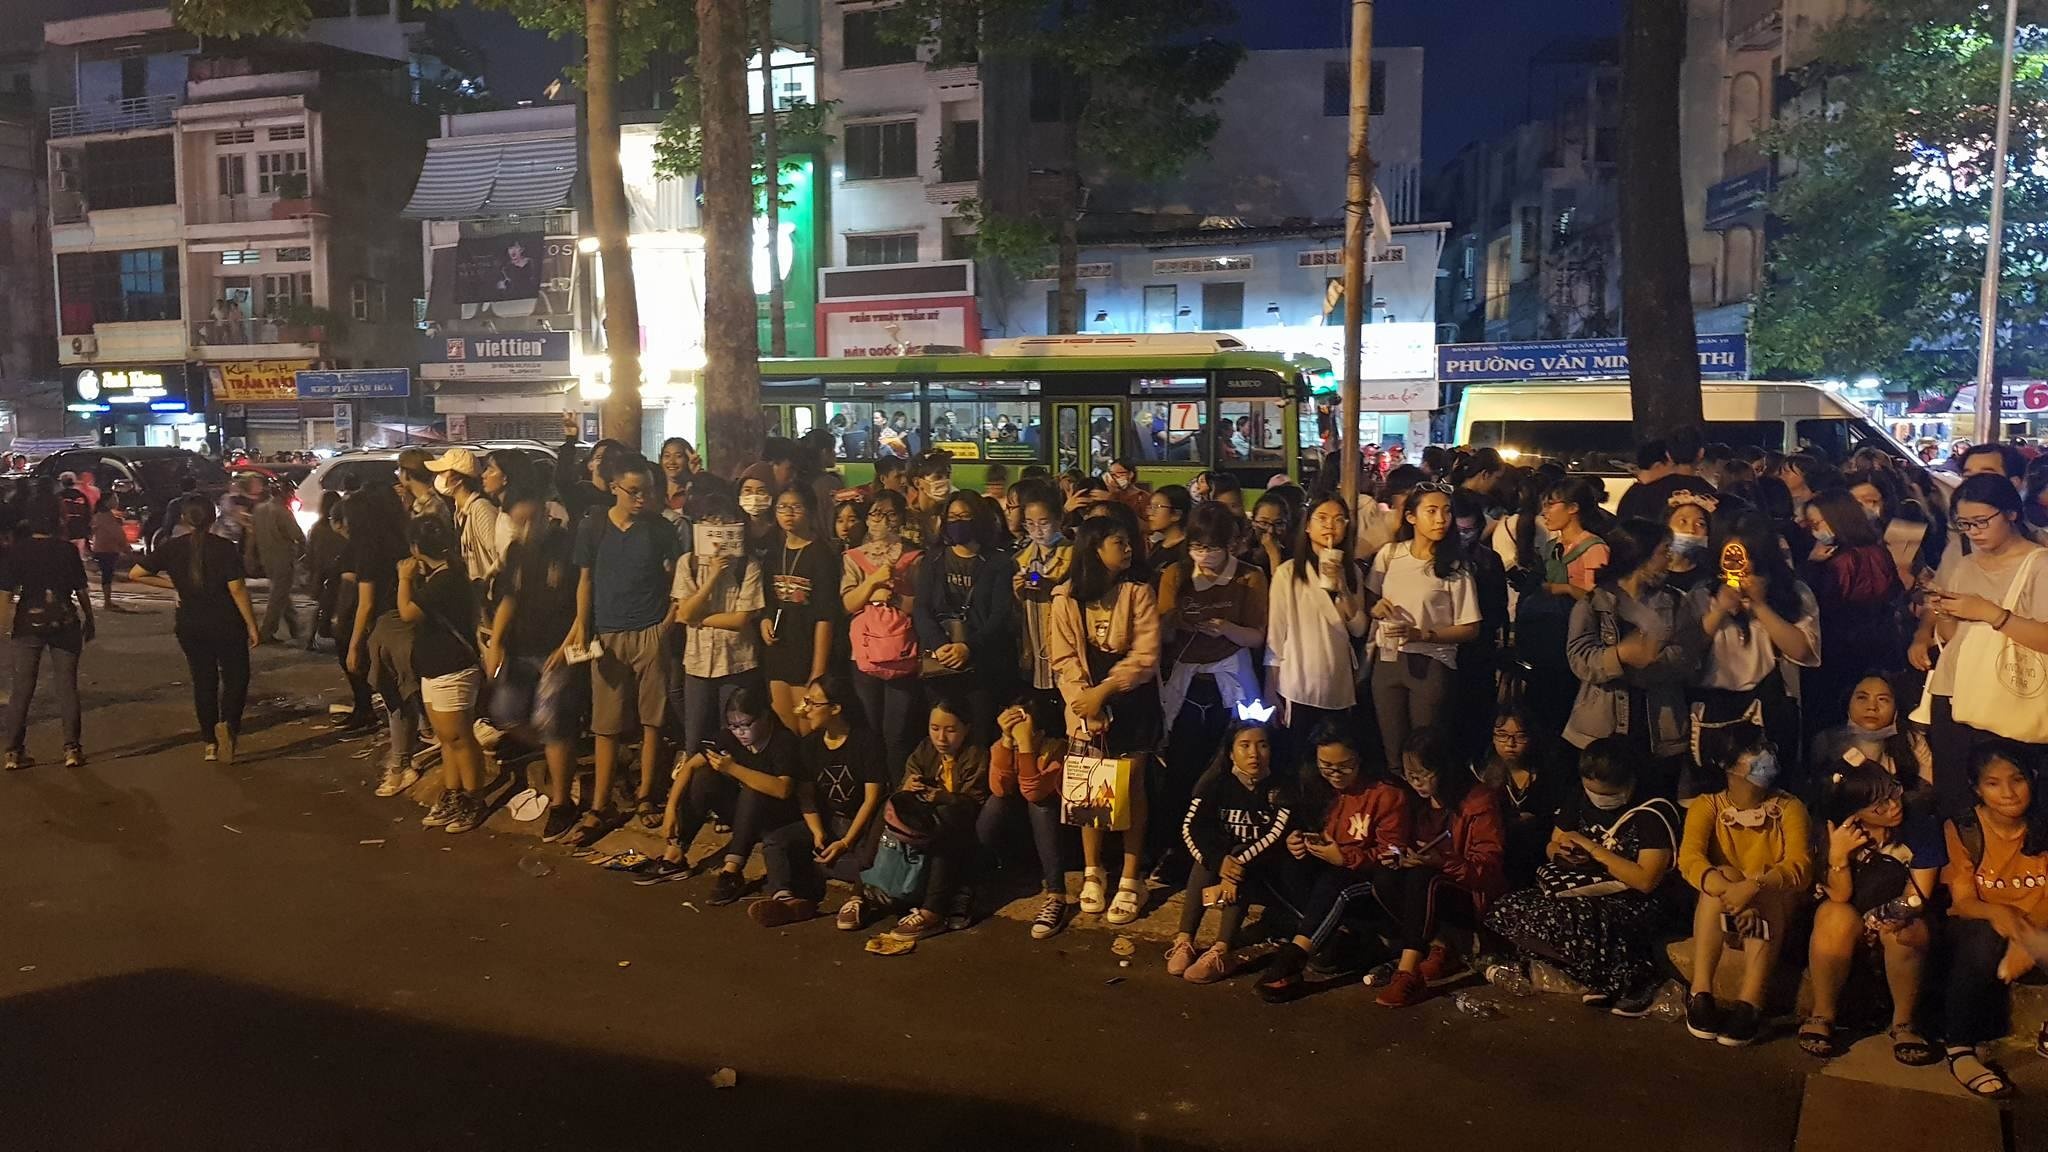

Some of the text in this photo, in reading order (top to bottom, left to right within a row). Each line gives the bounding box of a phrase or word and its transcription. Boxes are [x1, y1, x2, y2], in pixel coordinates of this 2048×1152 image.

[544, 244, 572, 256] OS
[475, 338, 543, 357] viettien
[1446, 355, 1535, 373] PHƯỜNG
[1541, 353, 1586, 370] VĂN
[1697, 351, 1736, 367] THỊ
[1177, 404, 1191, 429] 7
